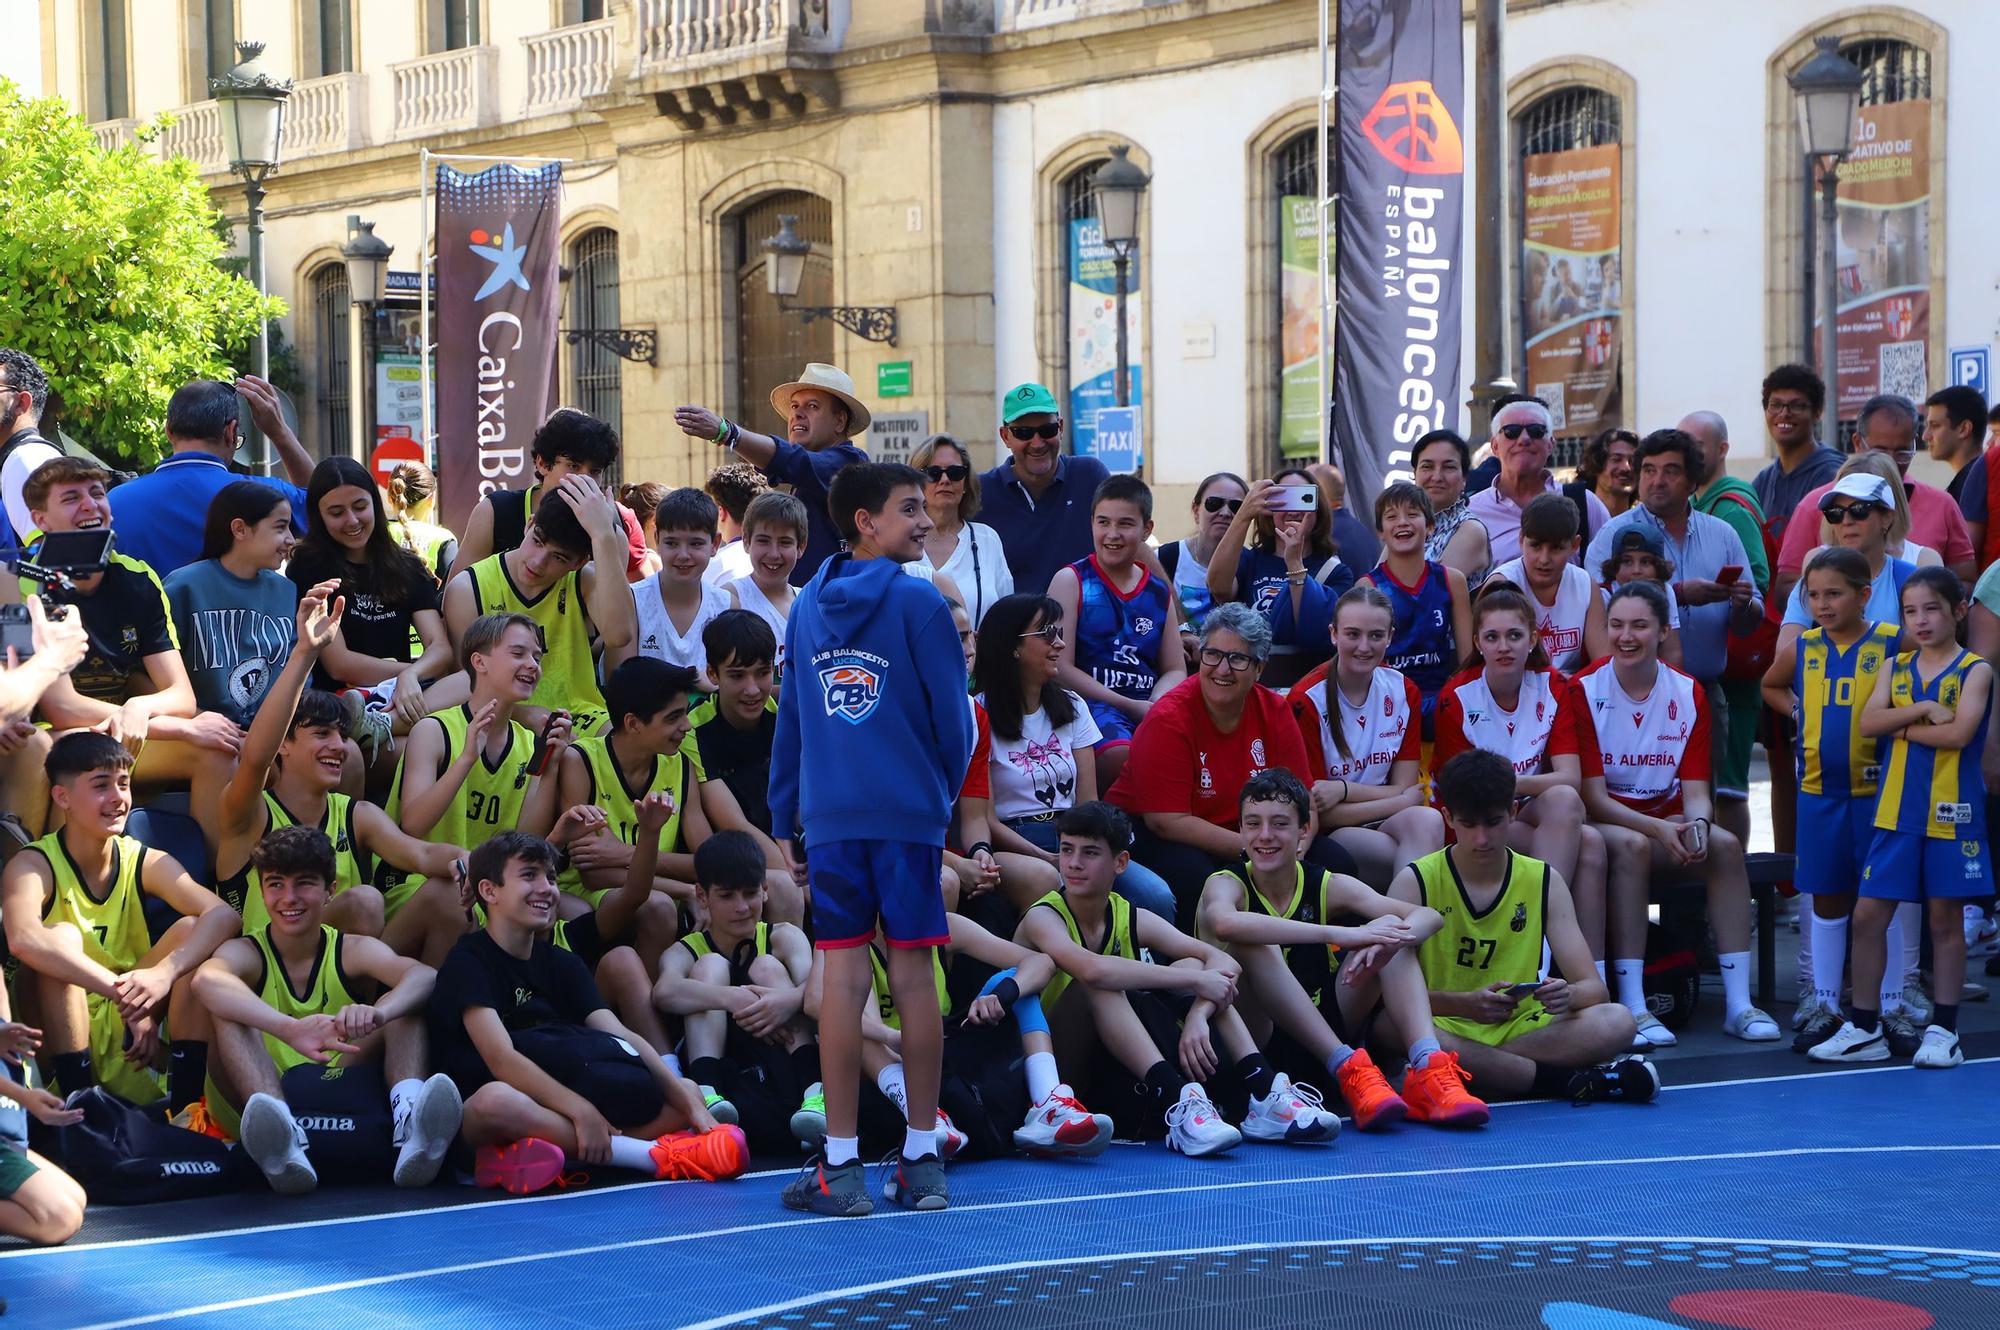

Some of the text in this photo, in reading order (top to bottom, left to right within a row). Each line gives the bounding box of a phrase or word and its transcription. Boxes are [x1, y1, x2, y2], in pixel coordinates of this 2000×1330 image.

[1895, 139, 1912, 153] DE
[1384, 185, 1405, 298] ESPAÑA
[1961, 359, 1979, 386] P
[1099, 432, 1133, 451] TAXI
[1433, 609, 1443, 627] 3
[192, 609, 246, 672] NEW
[1555, 632, 1577, 649] CABRA
[811, 648, 889, 668] CLUB BALONCESTO
[1821, 677, 1856, 707] 10
[1619, 750, 1677, 767] ALMERÍA
[466, 790, 500, 825] 30
[1456, 937, 1497, 970] 27
